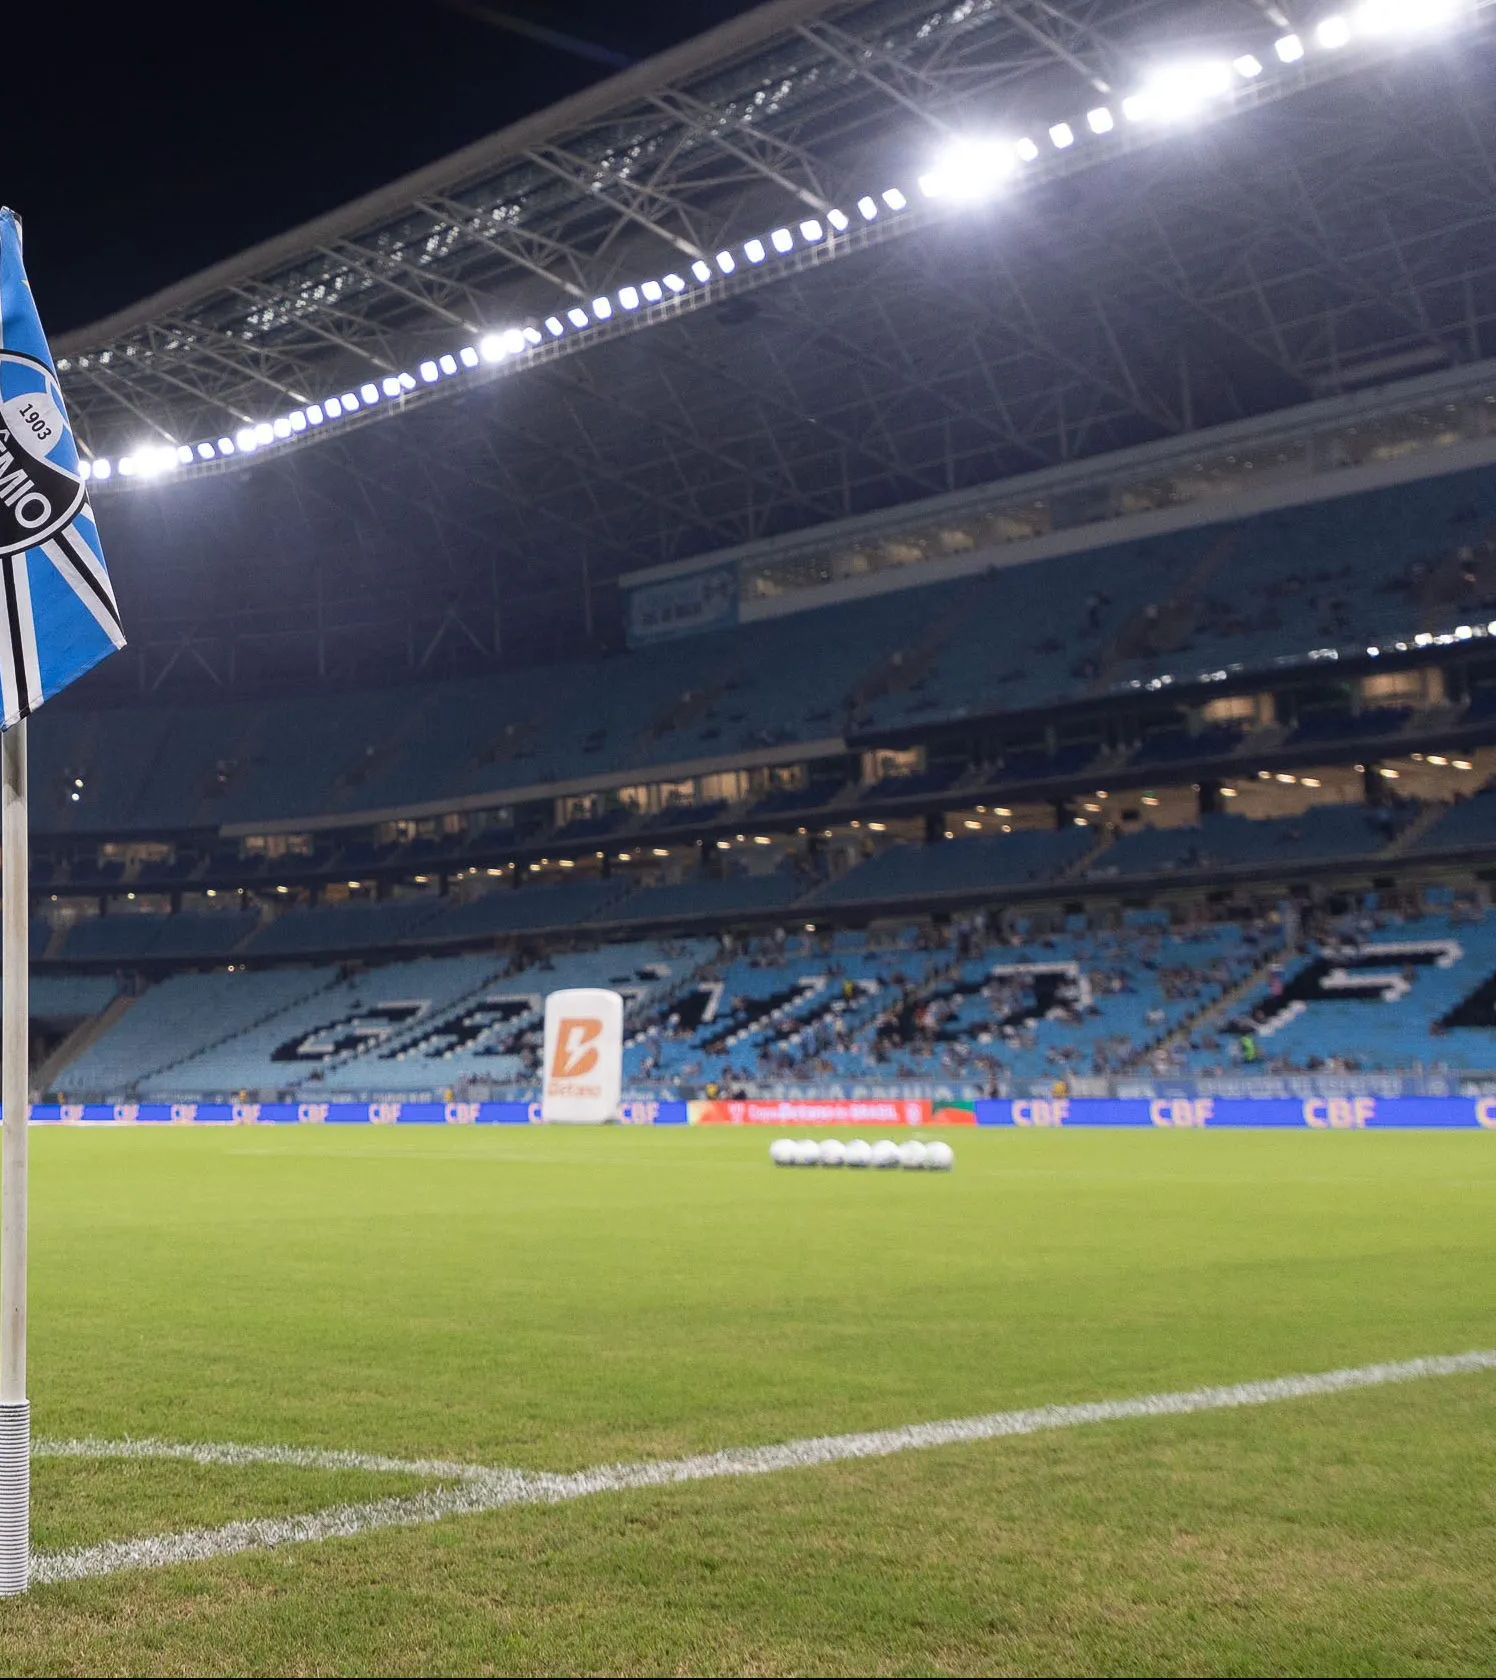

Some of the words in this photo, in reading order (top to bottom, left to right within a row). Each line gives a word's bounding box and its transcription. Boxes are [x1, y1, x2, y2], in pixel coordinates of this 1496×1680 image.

[19, 403, 52, 440] 1903
[1011, 1101, 1070, 1126] CBF
[1150, 1100, 1214, 1127] CBF
[1302, 1098, 1376, 1128] CBF
